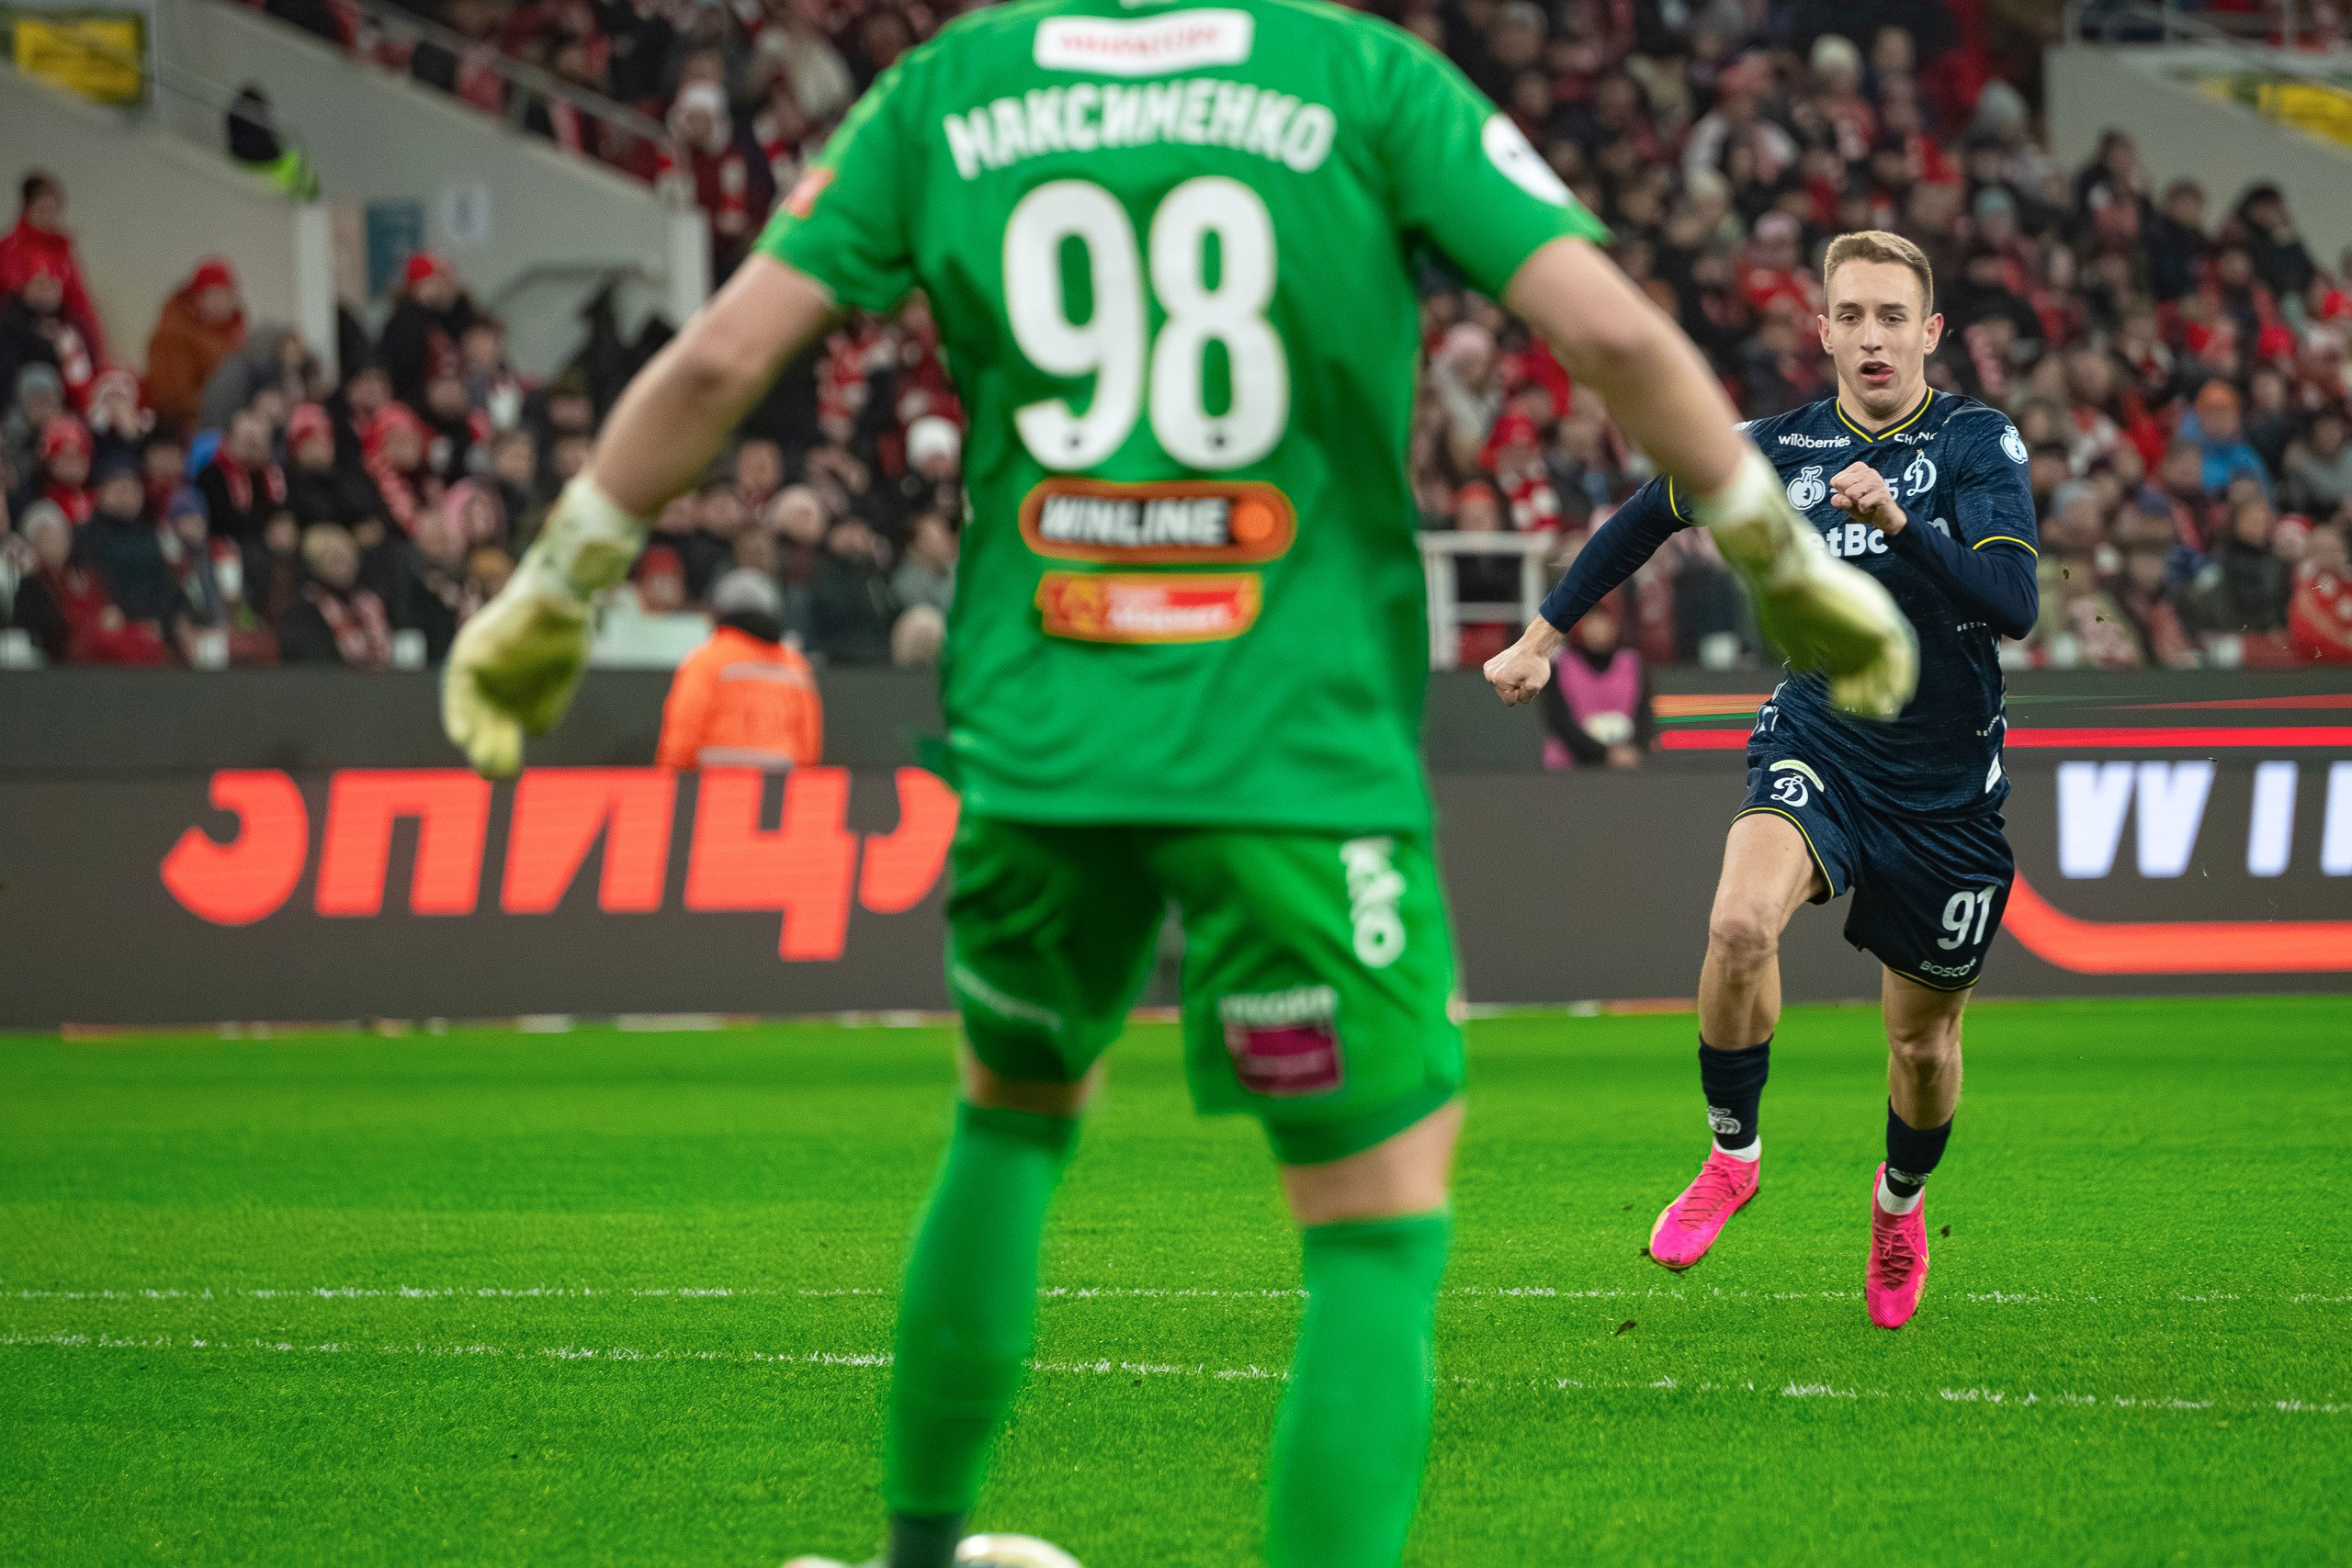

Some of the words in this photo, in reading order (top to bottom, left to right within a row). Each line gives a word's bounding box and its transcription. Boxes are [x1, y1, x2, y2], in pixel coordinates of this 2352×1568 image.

[943, 77, 1338, 181] МАКСИМЕНКО
[1003, 175, 1290, 470] 98
[1779, 434, 1851, 448] wildberries
[1039, 494, 1229, 547] WINLINE
[1937, 885, 1998, 950] 91
[1919, 960, 1971, 976] BOSCO
